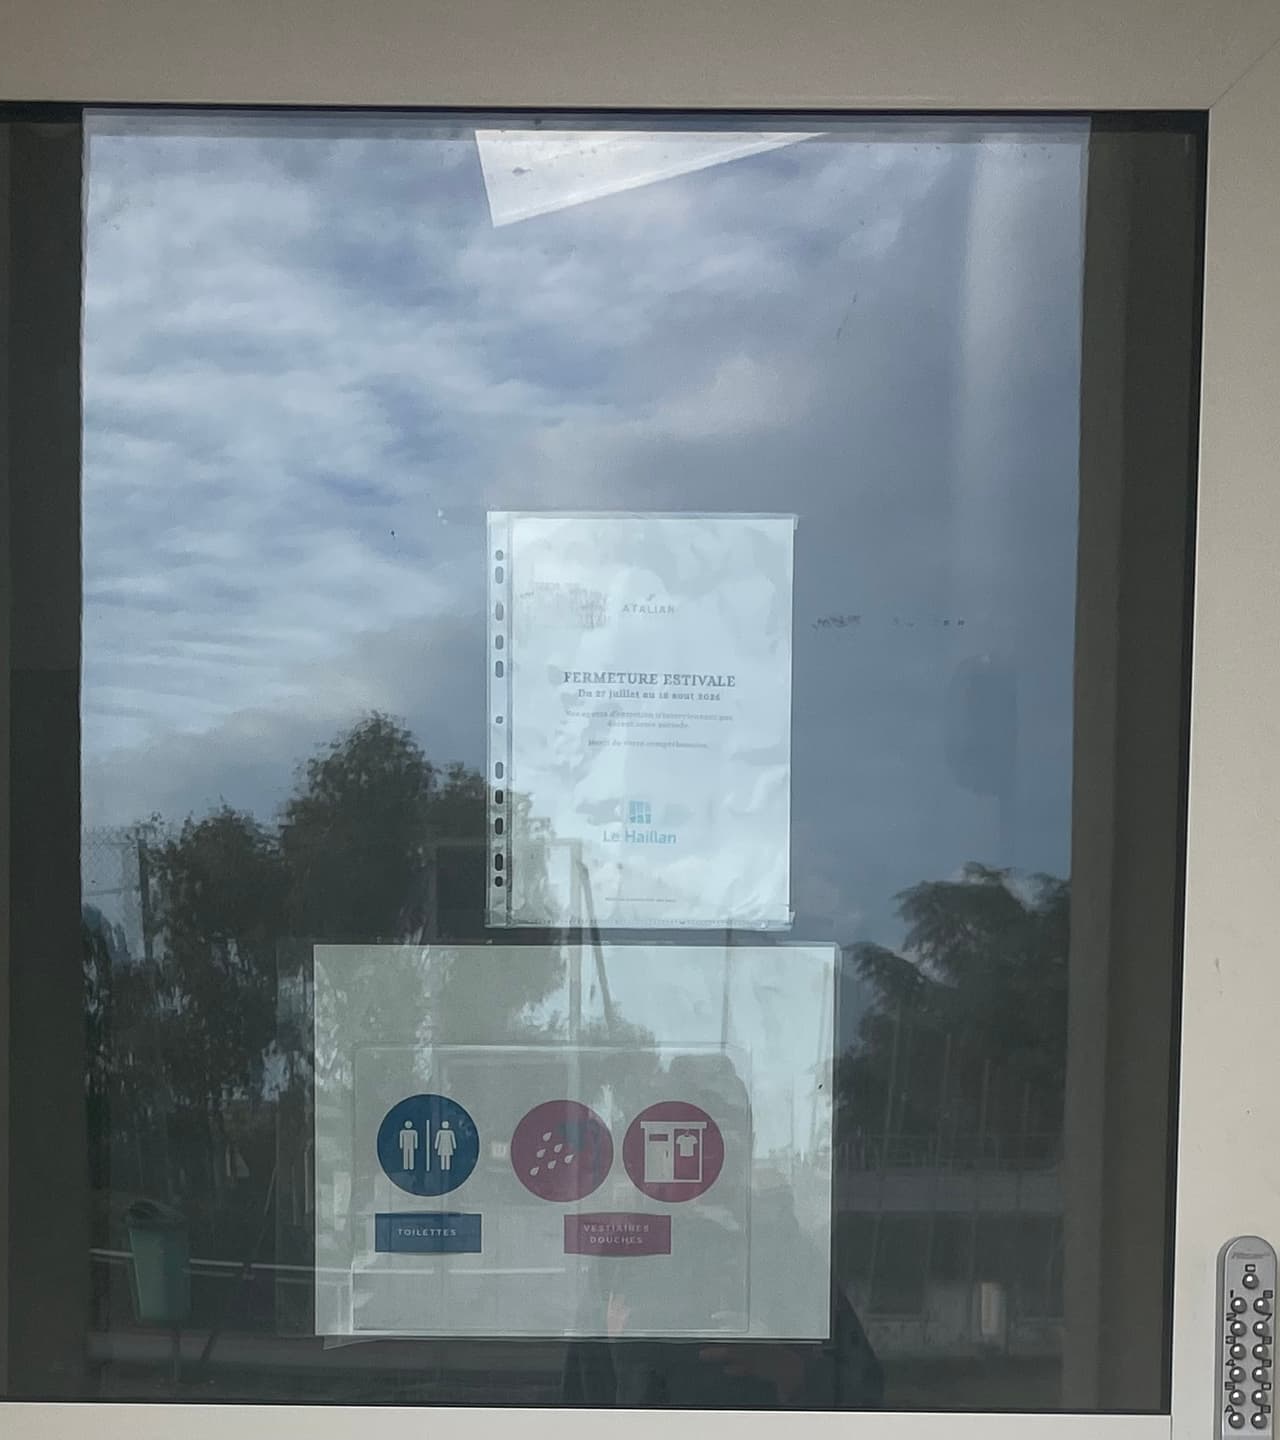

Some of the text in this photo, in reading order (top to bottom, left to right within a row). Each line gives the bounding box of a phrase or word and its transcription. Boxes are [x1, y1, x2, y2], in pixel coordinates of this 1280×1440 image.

[563, 671, 736, 688] FERMETURE ESTIVALE
[609, 688, 640, 700] juillet
[603, 829, 677, 845] Le Haillan
[397, 1227, 458, 1237] TOILETTES
[583, 1223, 650, 1233] VESTIAIRES
[589, 1235, 644, 1245] DOUCHES
